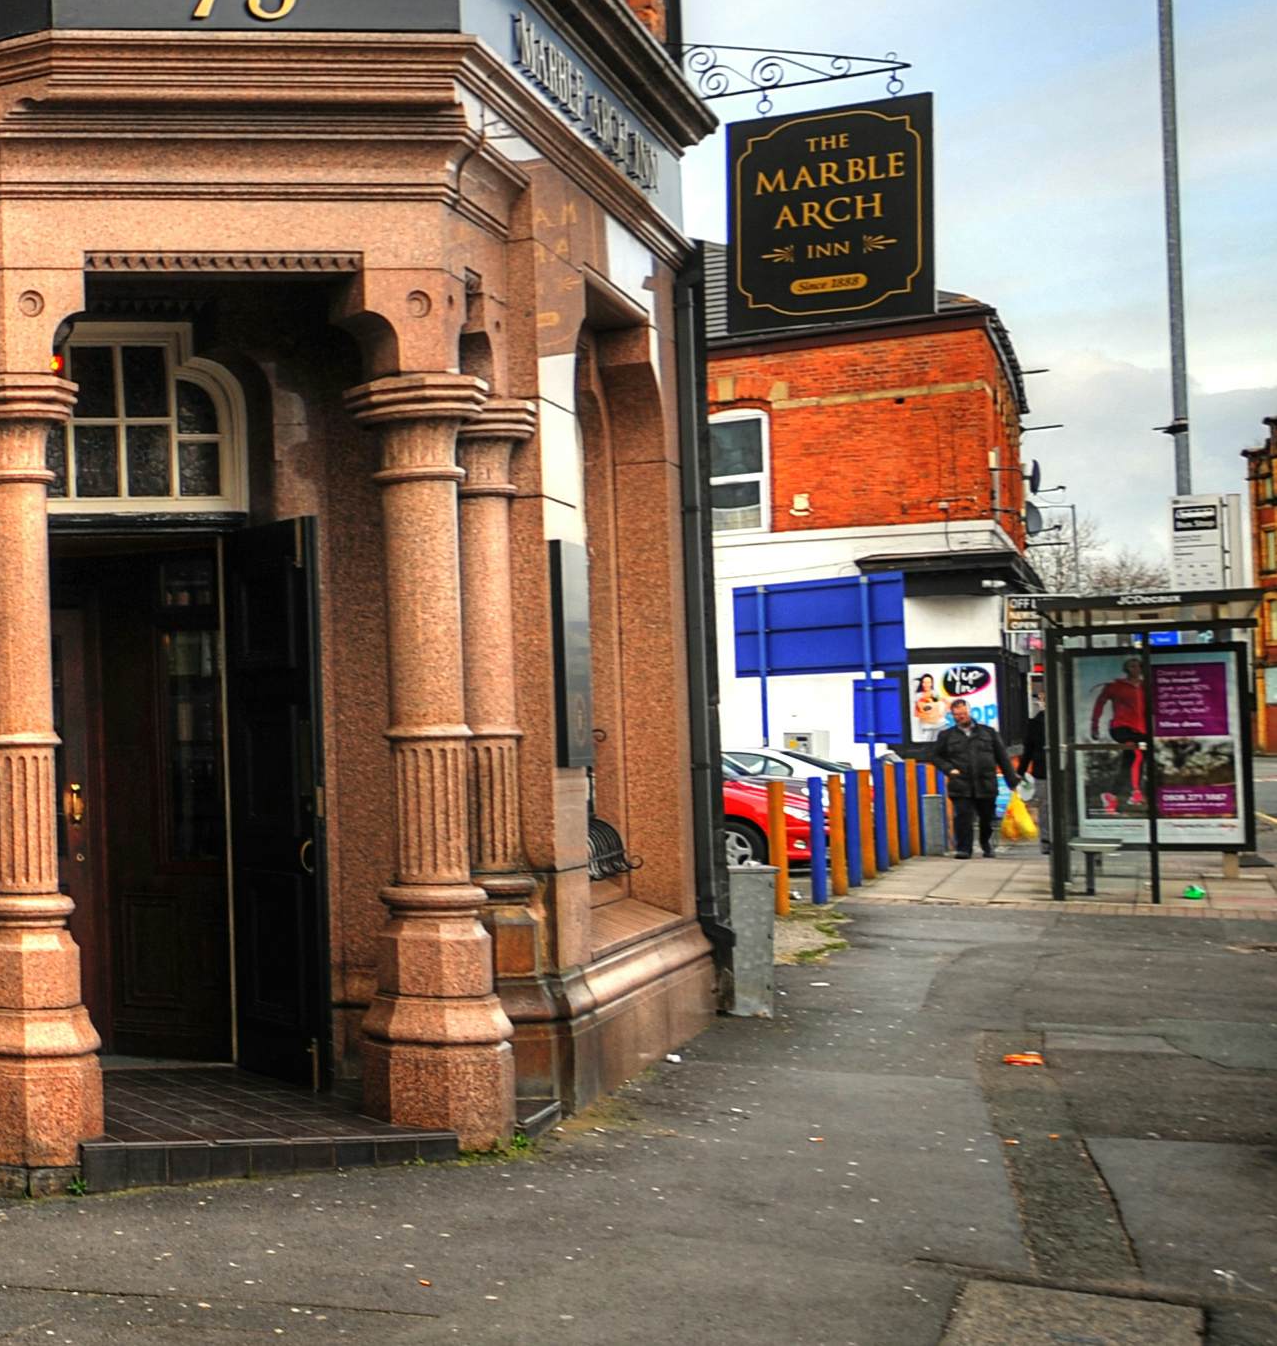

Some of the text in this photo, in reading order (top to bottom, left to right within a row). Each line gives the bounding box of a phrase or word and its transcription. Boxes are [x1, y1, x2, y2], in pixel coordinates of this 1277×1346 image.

[512, 11, 659, 192] MARBLE ARCH INN
[805, 133, 850, 152] THE
[755, 152, 905, 196] MARBLE
[774, 193, 884, 230] ARCH
[807, 241, 850, 259] INN
[797, 282, 828, 292] Since
[1116, 595, 1182, 605] JCDecaux
[948, 667, 984, 685] Nip
[955, 682, 977, 694] In
